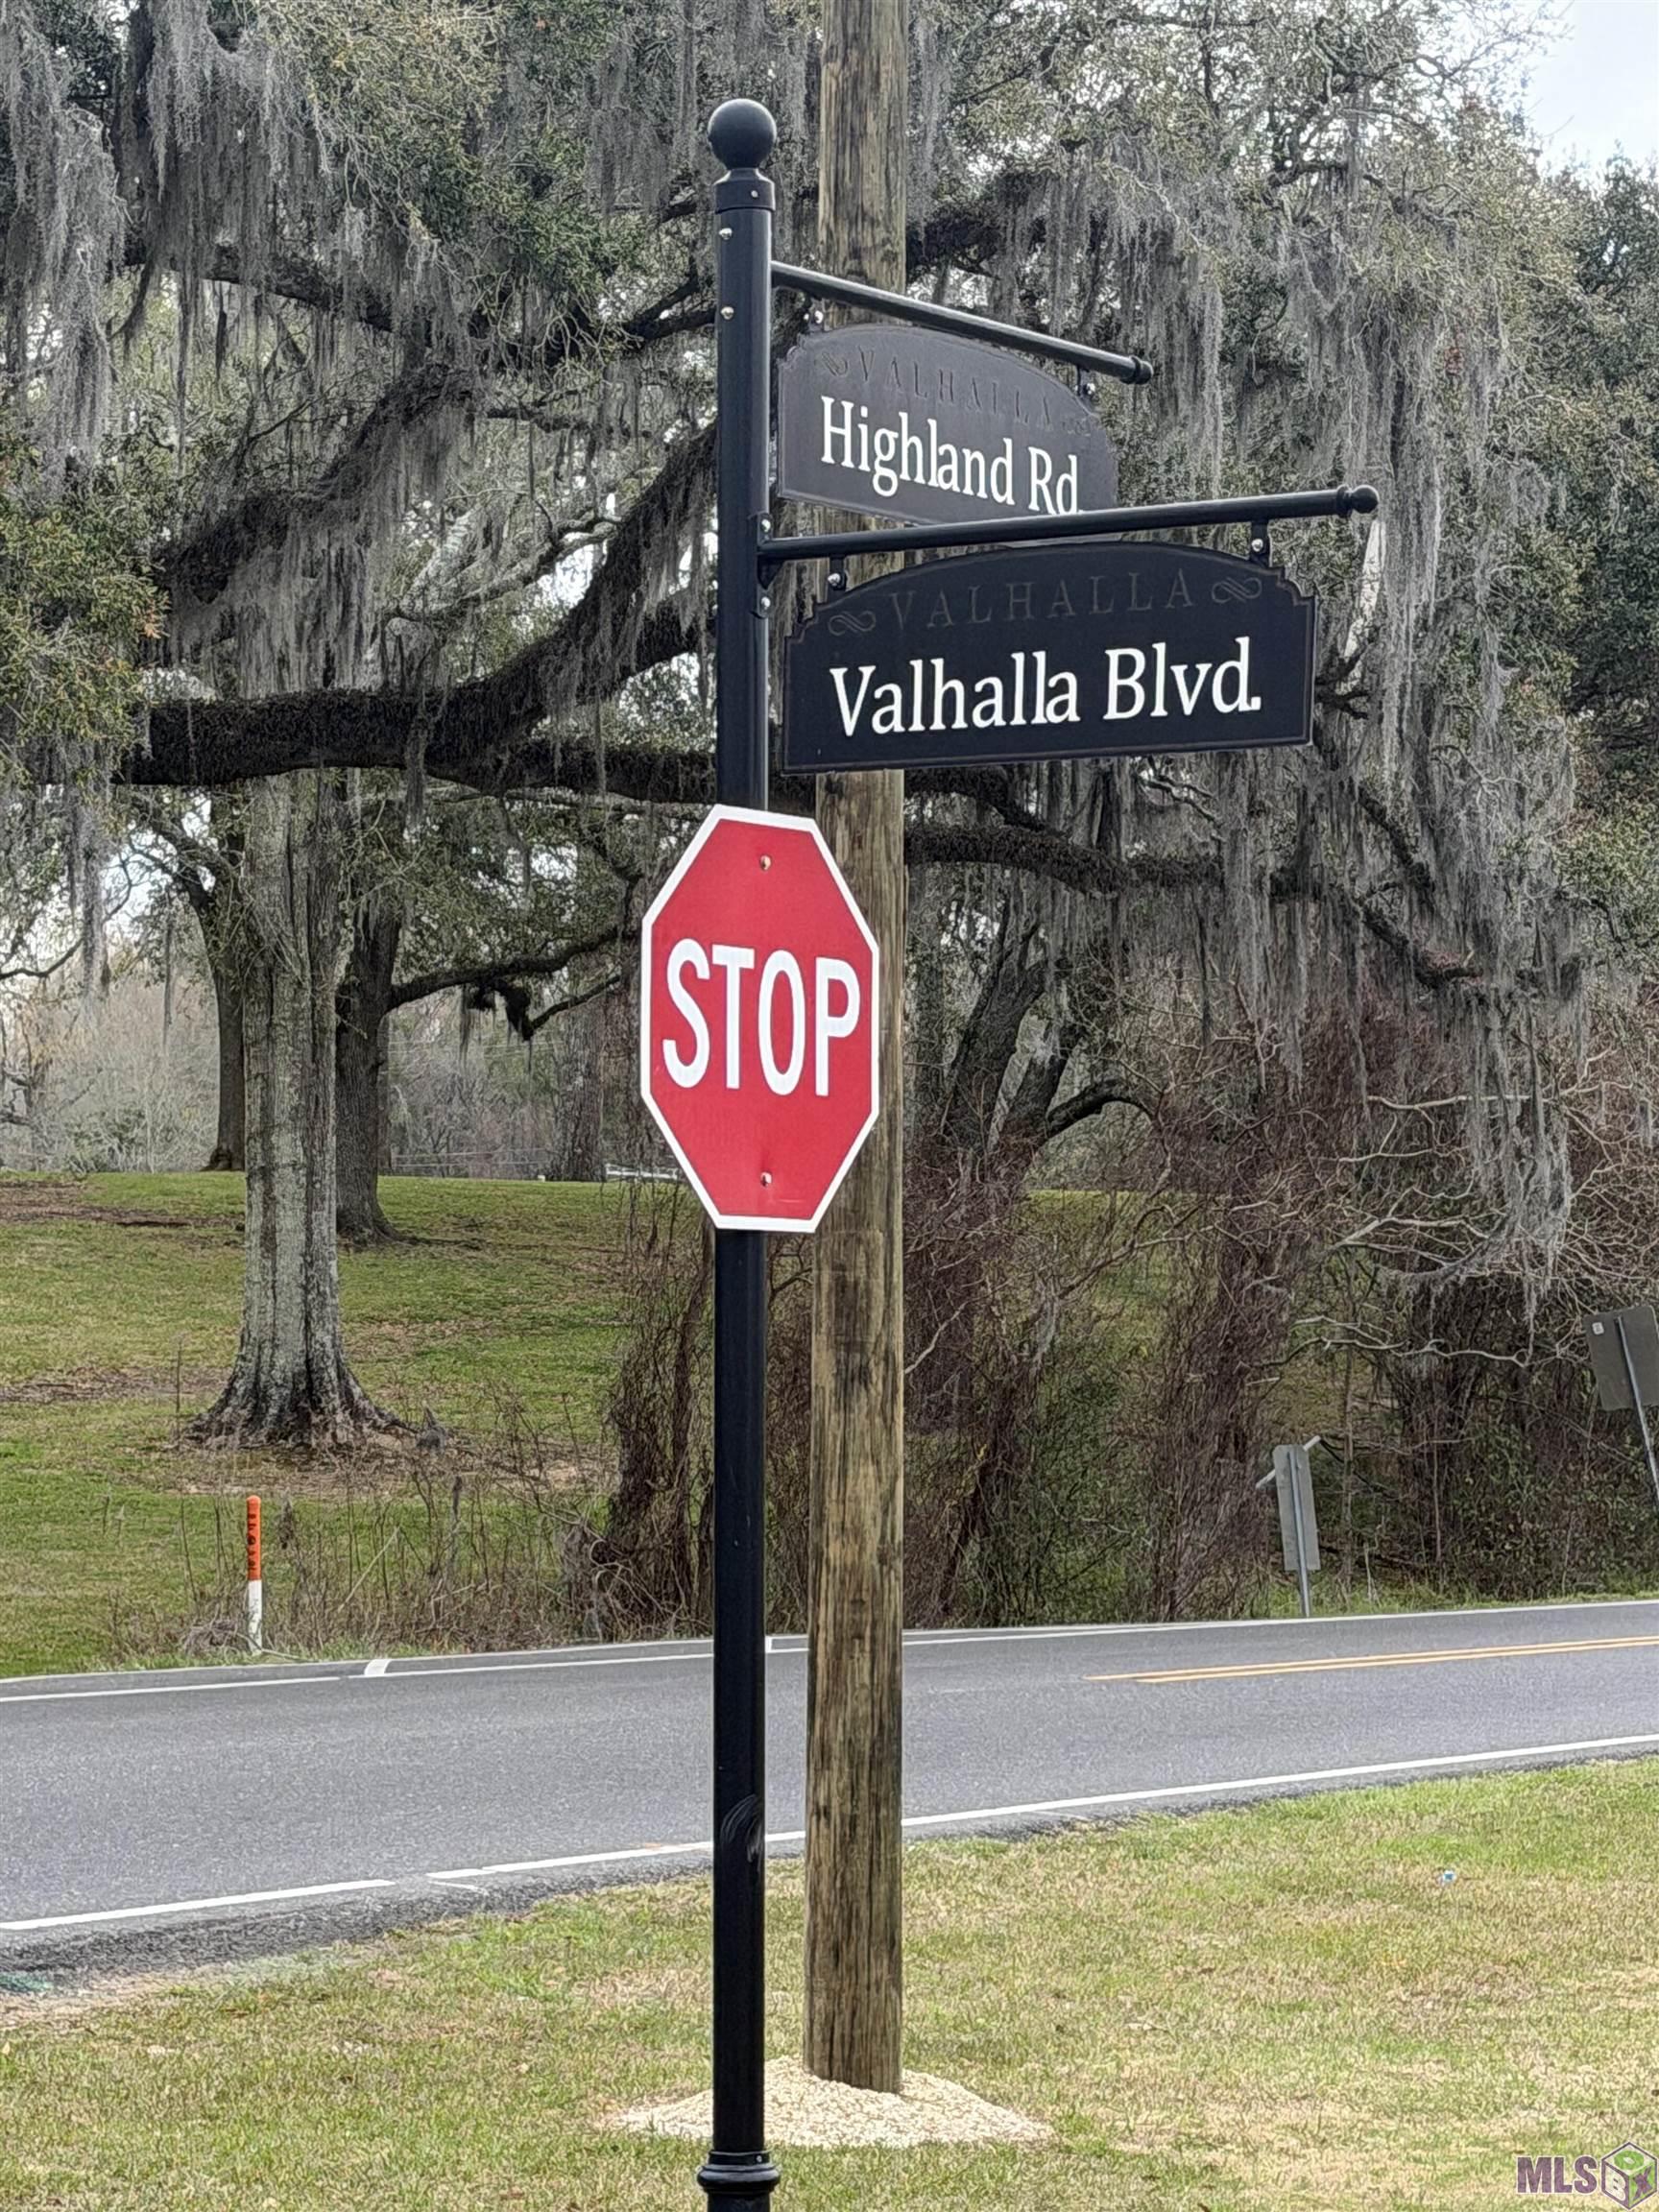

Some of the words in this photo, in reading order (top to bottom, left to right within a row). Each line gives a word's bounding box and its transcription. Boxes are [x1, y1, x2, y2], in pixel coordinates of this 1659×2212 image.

[857, 345, 1053, 430] VALHALLA
[820, 395, 1016, 506] Highland
[889, 568, 1196, 630] VALHALLA
[830, 651, 1081, 737] Valhalla
[1103, 637, 1262, 720] Blvd.
[662, 938, 861, 1097] STOP
